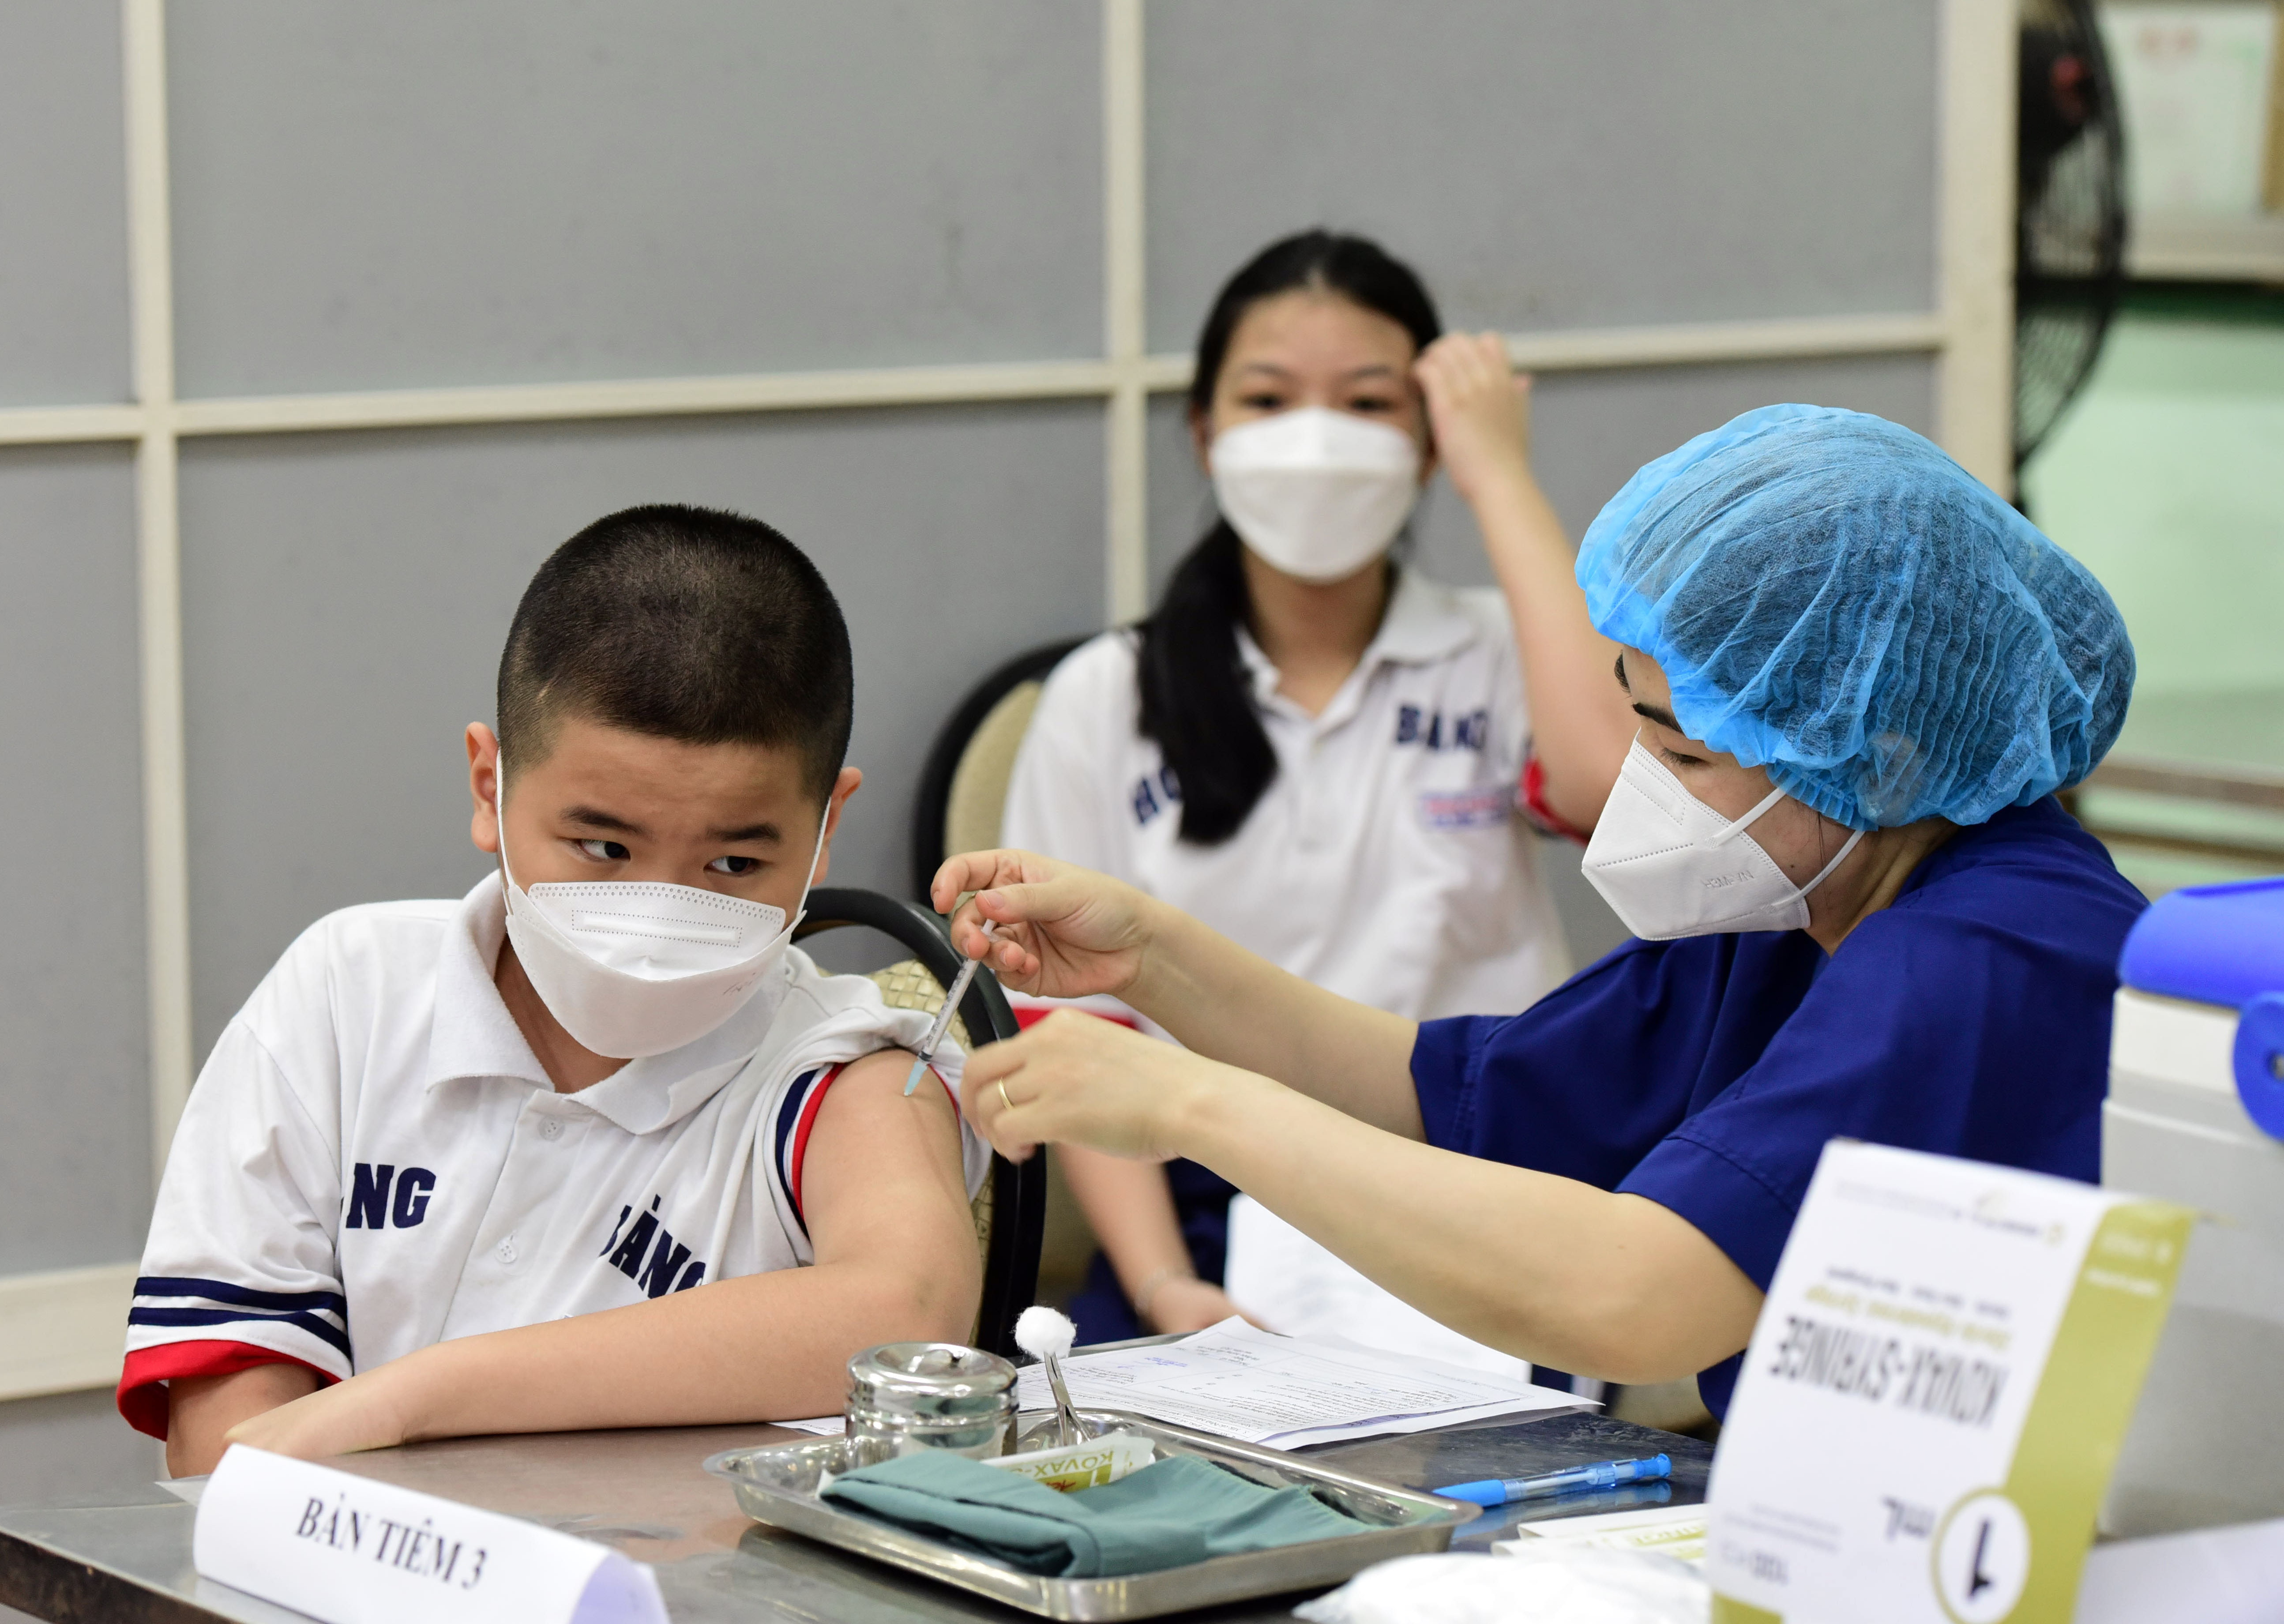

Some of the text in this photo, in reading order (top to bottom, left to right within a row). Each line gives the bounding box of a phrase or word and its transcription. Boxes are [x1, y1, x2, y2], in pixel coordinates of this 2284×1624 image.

[340, 1163, 436, 1229] NG
[1769, 1316, 2011, 1429] KOVAX-SYRINGE
[1012, 1451, 1114, 1477] KOVAX-
[376, 1518, 462, 1583] TIÊM
[461, 1548, 488, 1590] 3
[1966, 1516, 1995, 1601] 1
